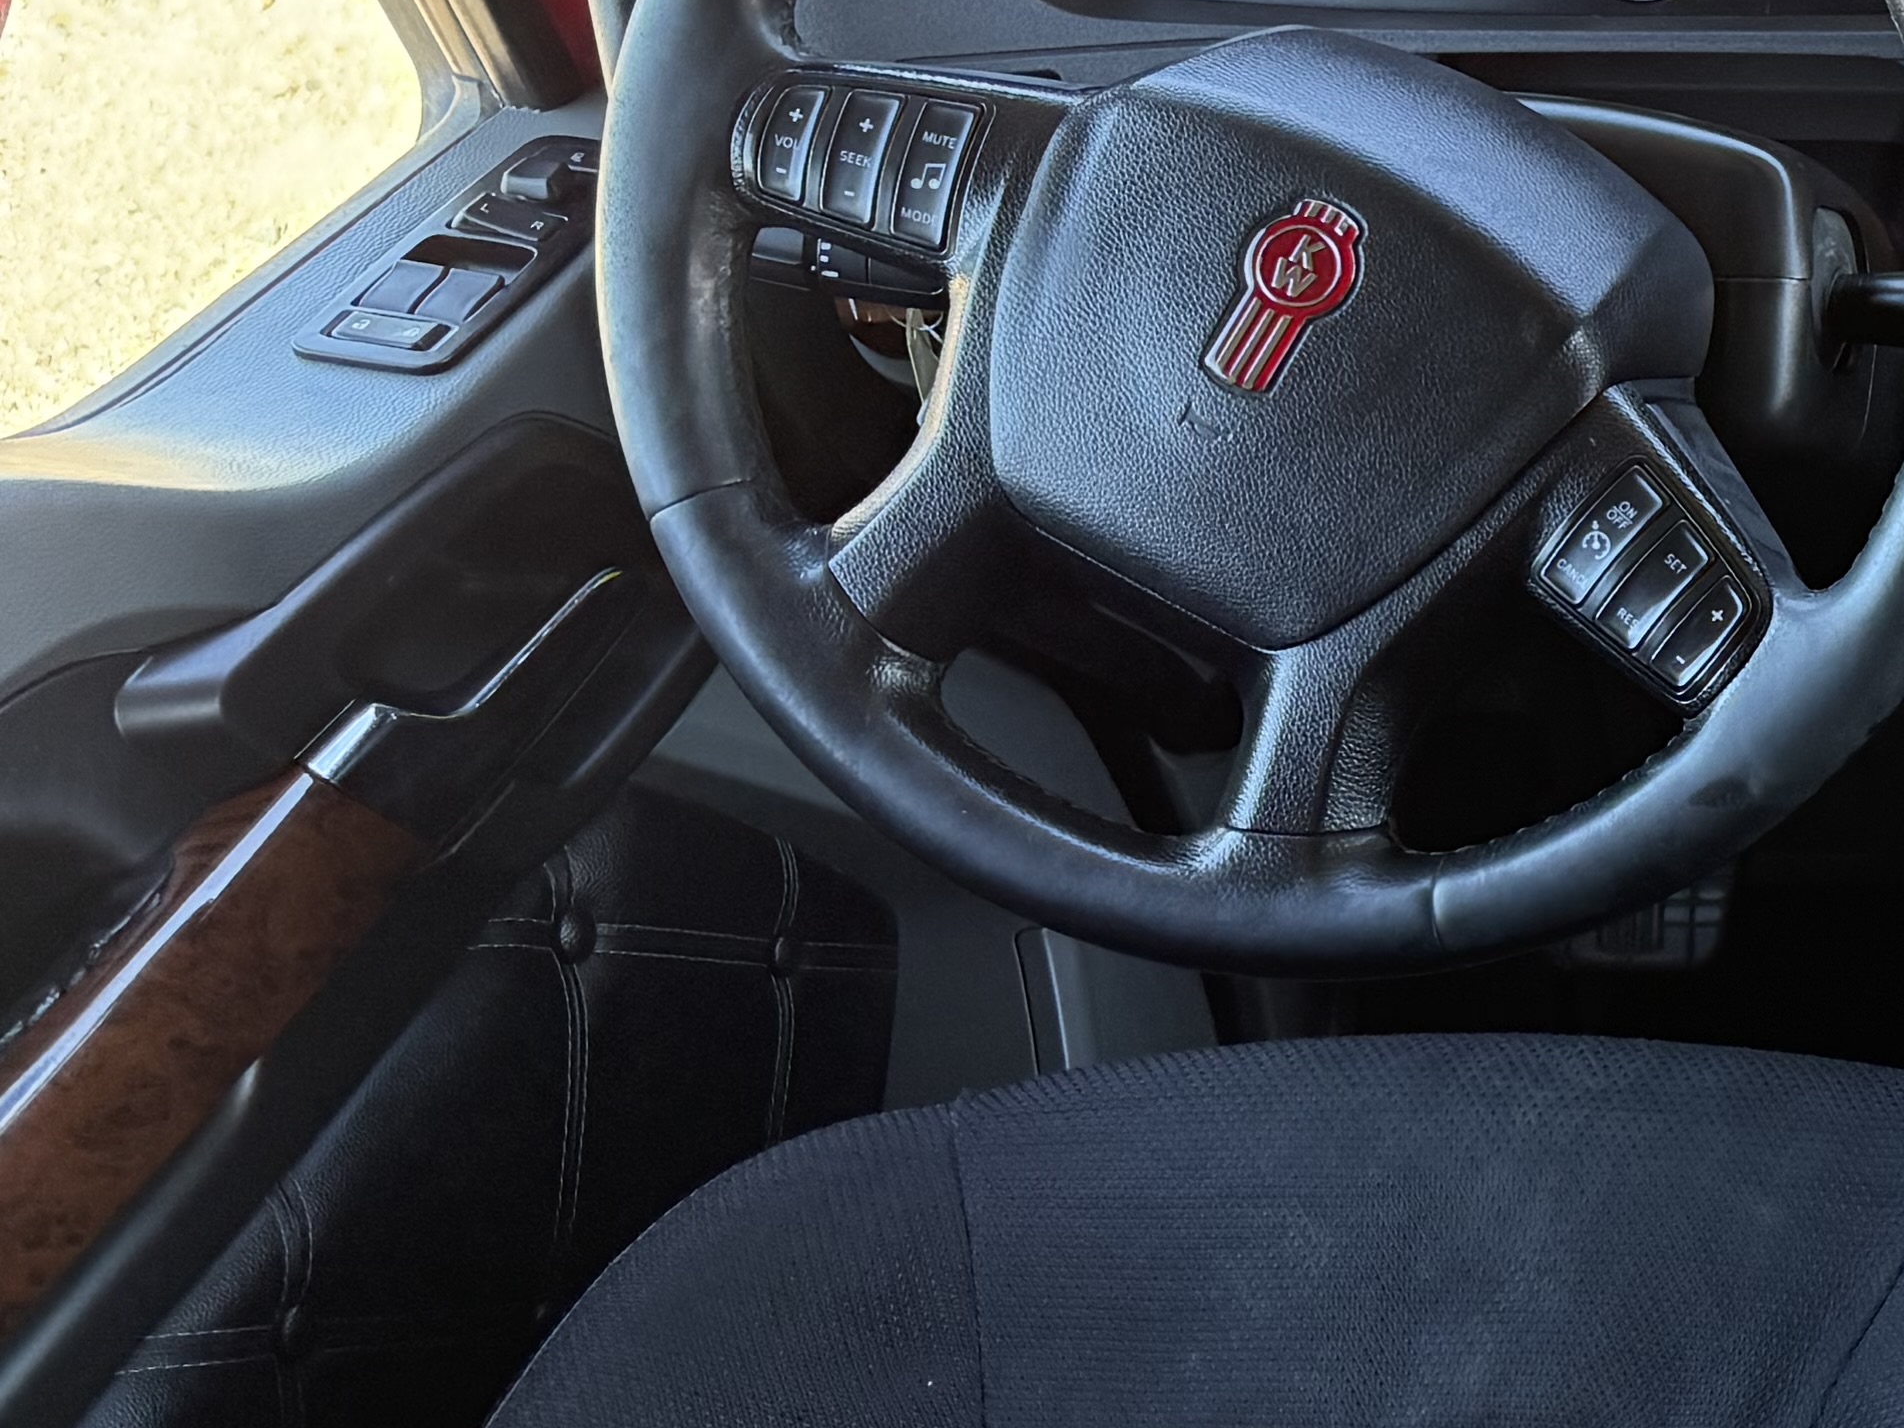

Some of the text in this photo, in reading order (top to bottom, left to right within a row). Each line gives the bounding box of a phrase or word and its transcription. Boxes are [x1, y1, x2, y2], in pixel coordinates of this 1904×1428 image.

[774, 133, 801, 152] VOL
[922, 130, 958, 150] MUTE
[839, 150, 873, 170] SEEK
[1606, 510, 1633, 530] OFF
[1617, 500, 1639, 521] ON
[1664, 553, 1689, 575] SET
